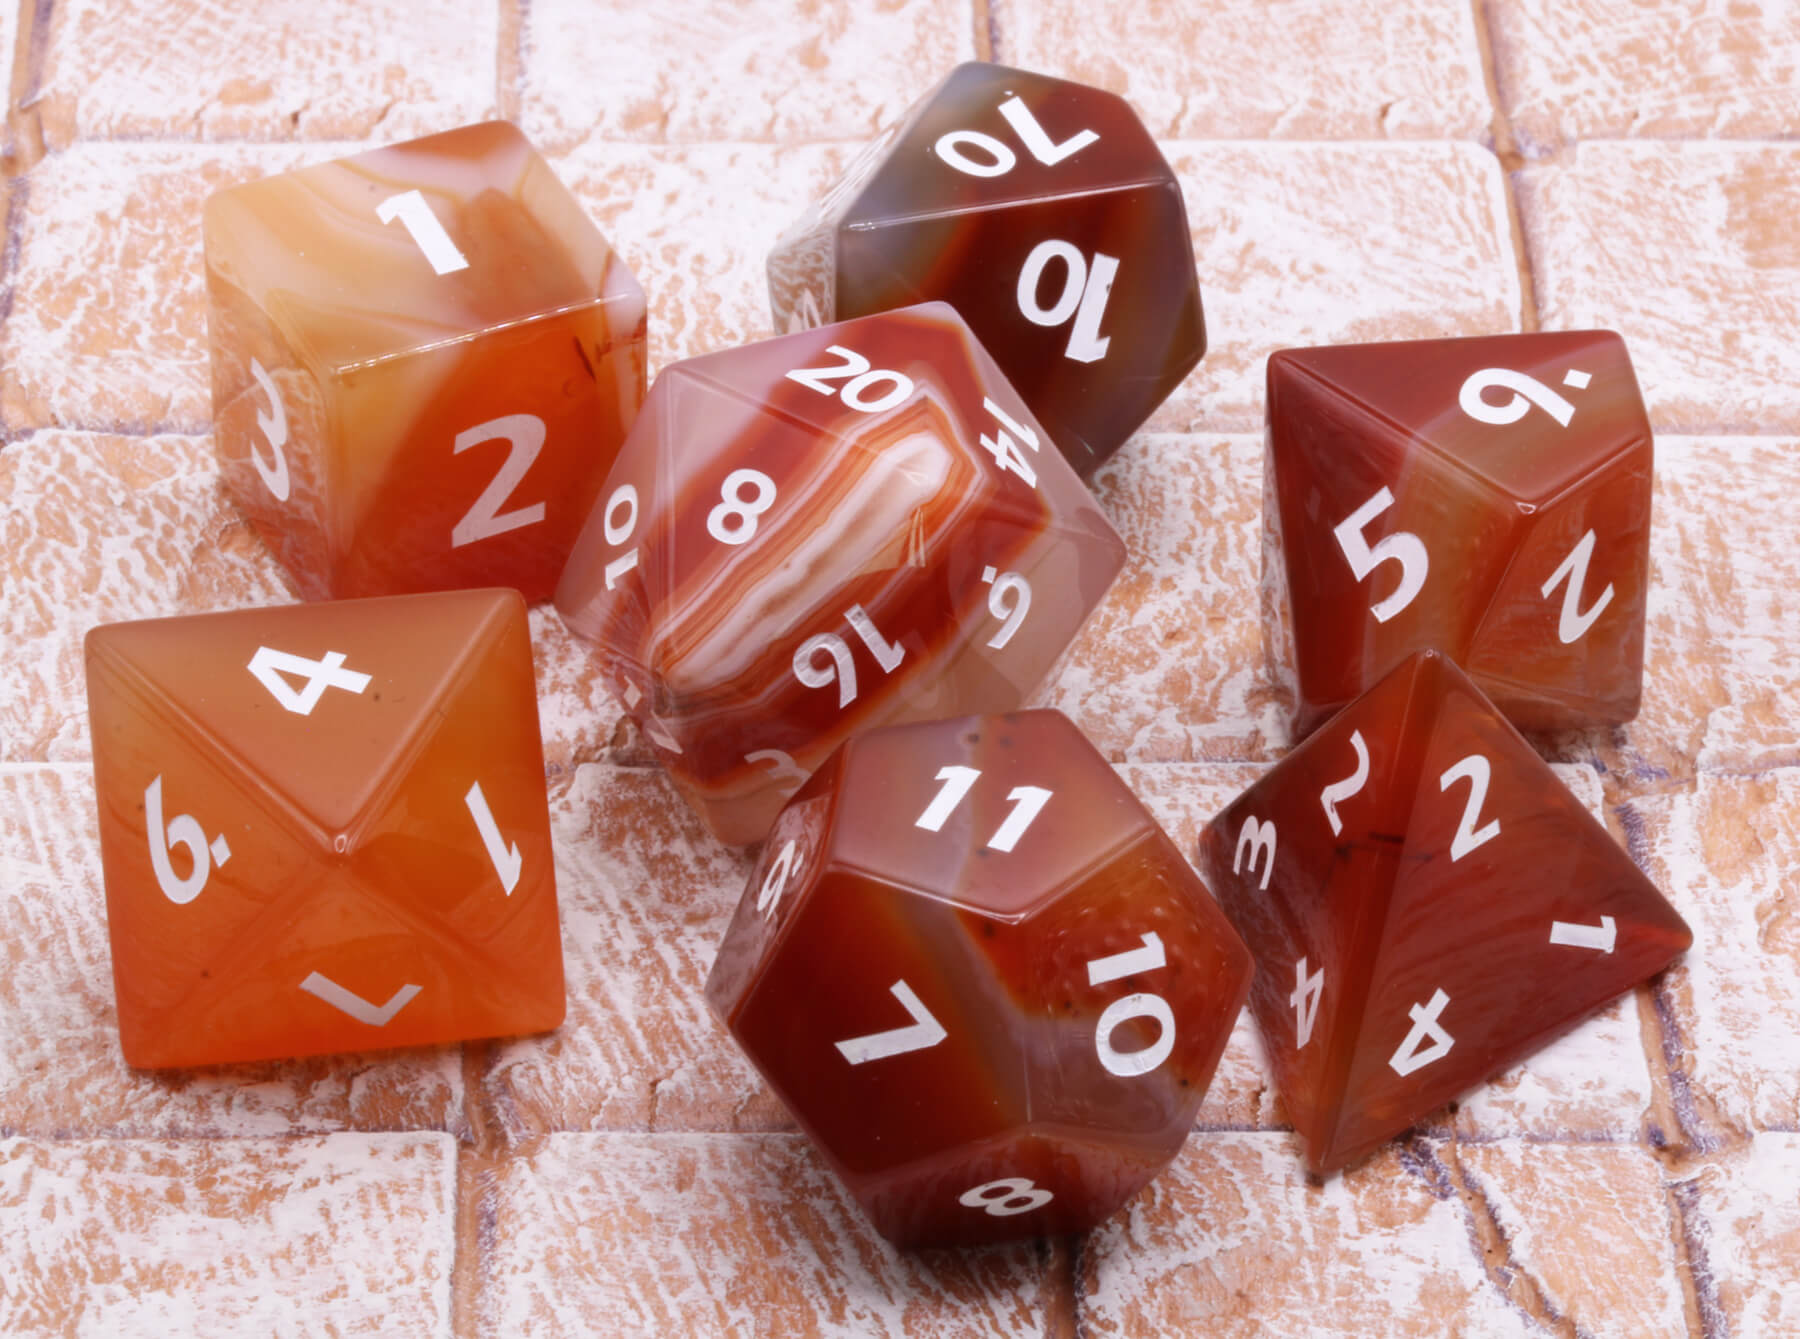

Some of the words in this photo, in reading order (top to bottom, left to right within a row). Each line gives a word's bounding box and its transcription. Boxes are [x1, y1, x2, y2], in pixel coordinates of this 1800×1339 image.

[934, 96, 1100, 177] 70
[375, 189, 470, 275] 1
[1017, 239, 1120, 364] 10
[785, 345, 914, 412] 20
[251, 357, 291, 502] 3
[979, 396, 1040, 488] 14
[451, 413, 547, 549] 2
[706, 468, 777, 545] 8
[604, 484, 639, 591] 10
[1334, 485, 1429, 624] 5
[1541, 528, 1615, 644] 2
[247, 646, 373, 716] 4
[792, 603, 905, 709] 16
[464, 779, 523, 897] 1
[914, 765, 1053, 852] 11
[1233, 815, 1277, 890] 3
[1440, 754, 1501, 862] 2
[1549, 916, 1617, 954] 1
[300, 971, 424, 1027] 7
[834, 978, 948, 1066] 7
[1087, 931, 1176, 1077] 10
[1290, 956, 1325, 1050] 4
[1389, 987, 1455, 1077] 4
[959, 1177, 1054, 1217] 8
